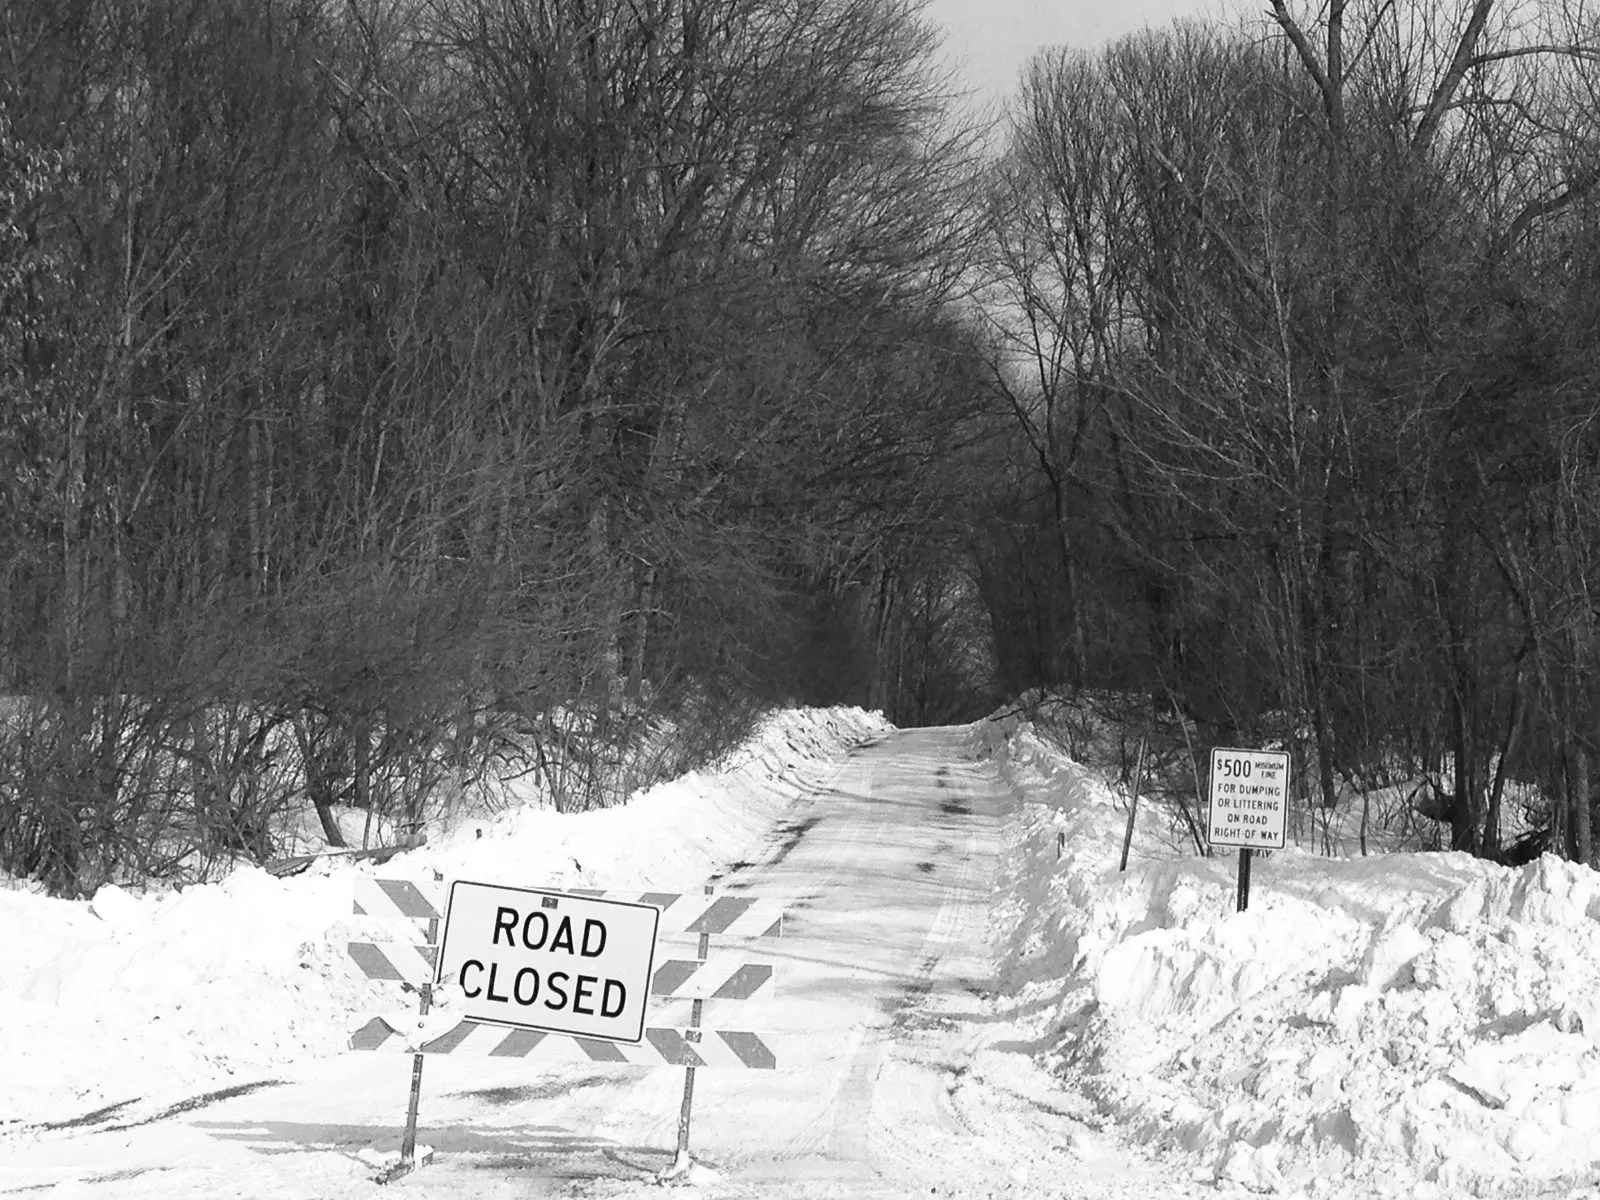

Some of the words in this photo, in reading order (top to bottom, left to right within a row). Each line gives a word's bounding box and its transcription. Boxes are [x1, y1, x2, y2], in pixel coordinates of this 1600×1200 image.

[1217, 758, 1251, 778] $500
[1218, 783, 1236, 793] FOR
[1240, 784, 1280, 797] DUMPING
[1218, 798, 1230, 808] OR
[1233, 798, 1279, 811] LITTERING
[1227, 813, 1240, 823] ON
[1243, 814, 1268, 825] ROAD
[1214, 827, 1240, 838] RIGHT
[1244, 829, 1256, 839] OF
[1261, 831, 1279, 840] WAY
[492, 906, 607, 958] ROAD
[459, 959, 627, 1018] CLOSED
